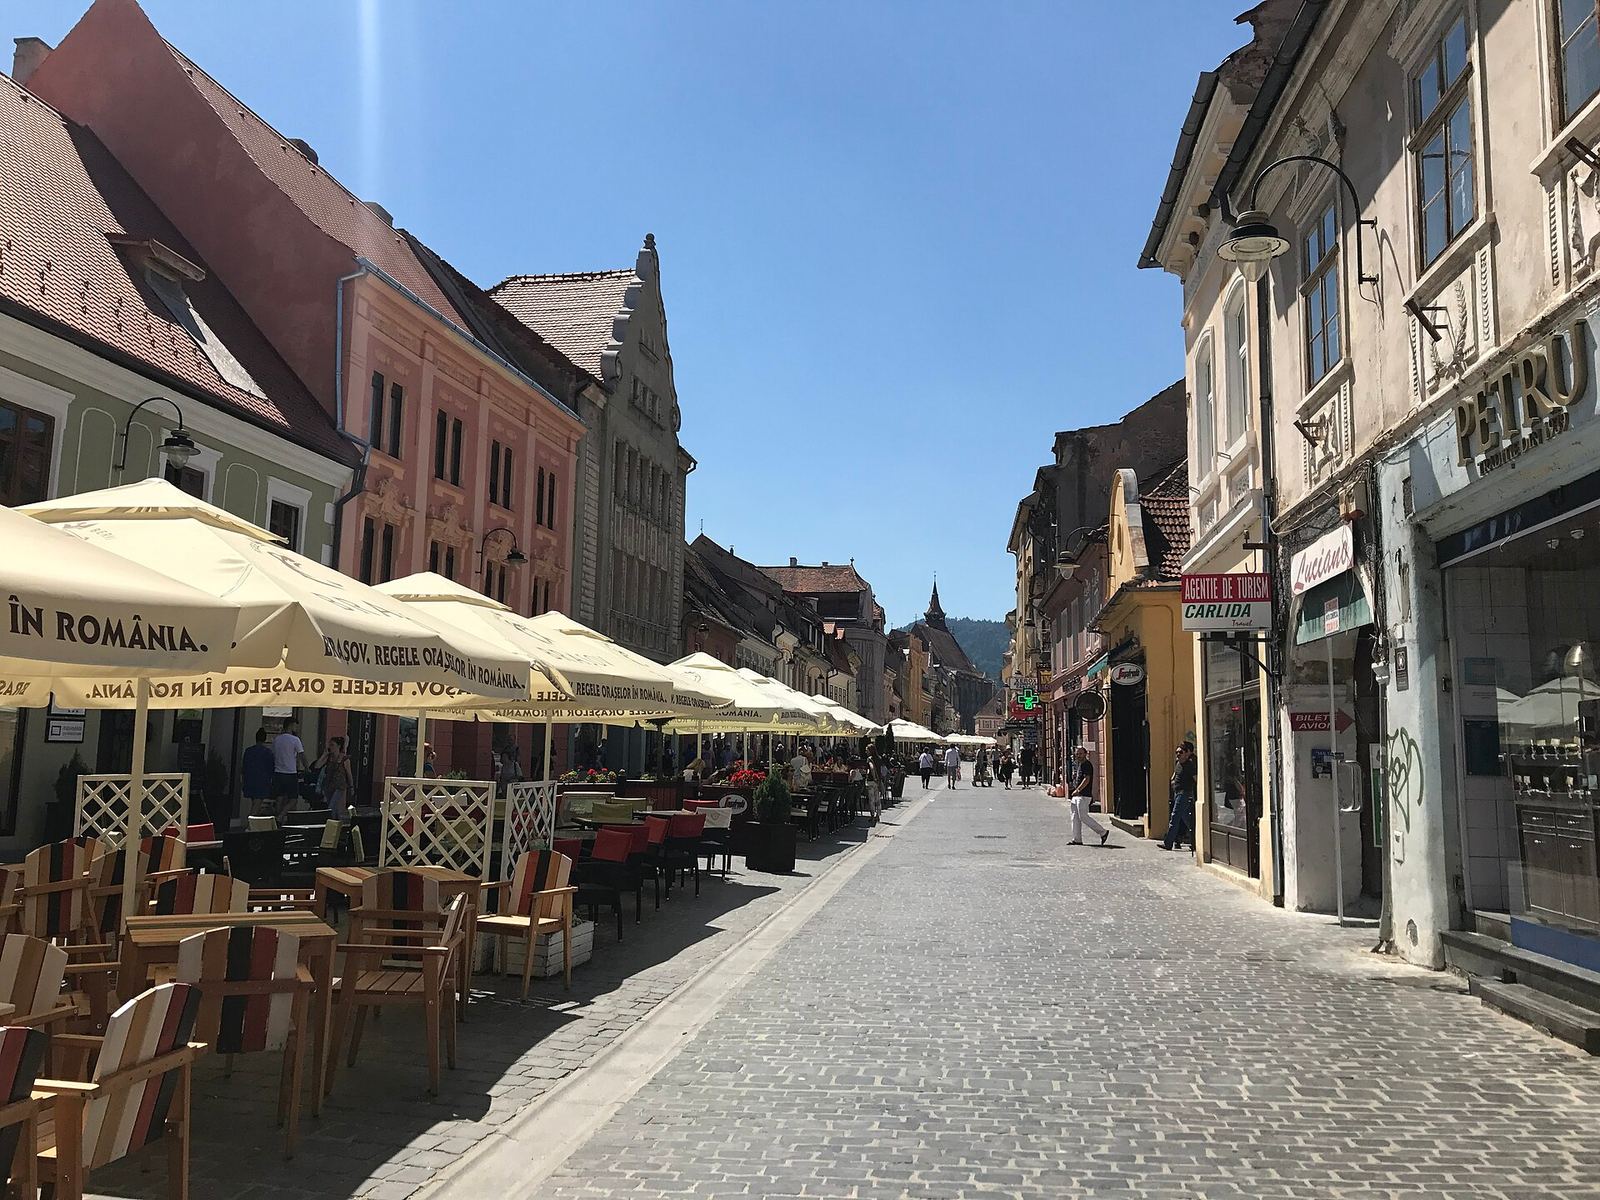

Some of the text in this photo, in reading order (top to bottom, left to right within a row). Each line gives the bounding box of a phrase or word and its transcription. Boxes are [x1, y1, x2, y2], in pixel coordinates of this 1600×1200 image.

[1455, 318, 1588, 467] PETRU
[1184, 576, 1269, 600] AGENTIE DE TURISM
[8, 594, 208, 652] ÎN ROMÂNIA.
[1184, 603, 1251, 618] CARLIDA
[374, 644, 420, 666] REGELE
[468, 658, 477, 681] ÎN
[479, 666, 526, 690] ROMÂNIA.
[576, 682, 600, 697] REGELE
